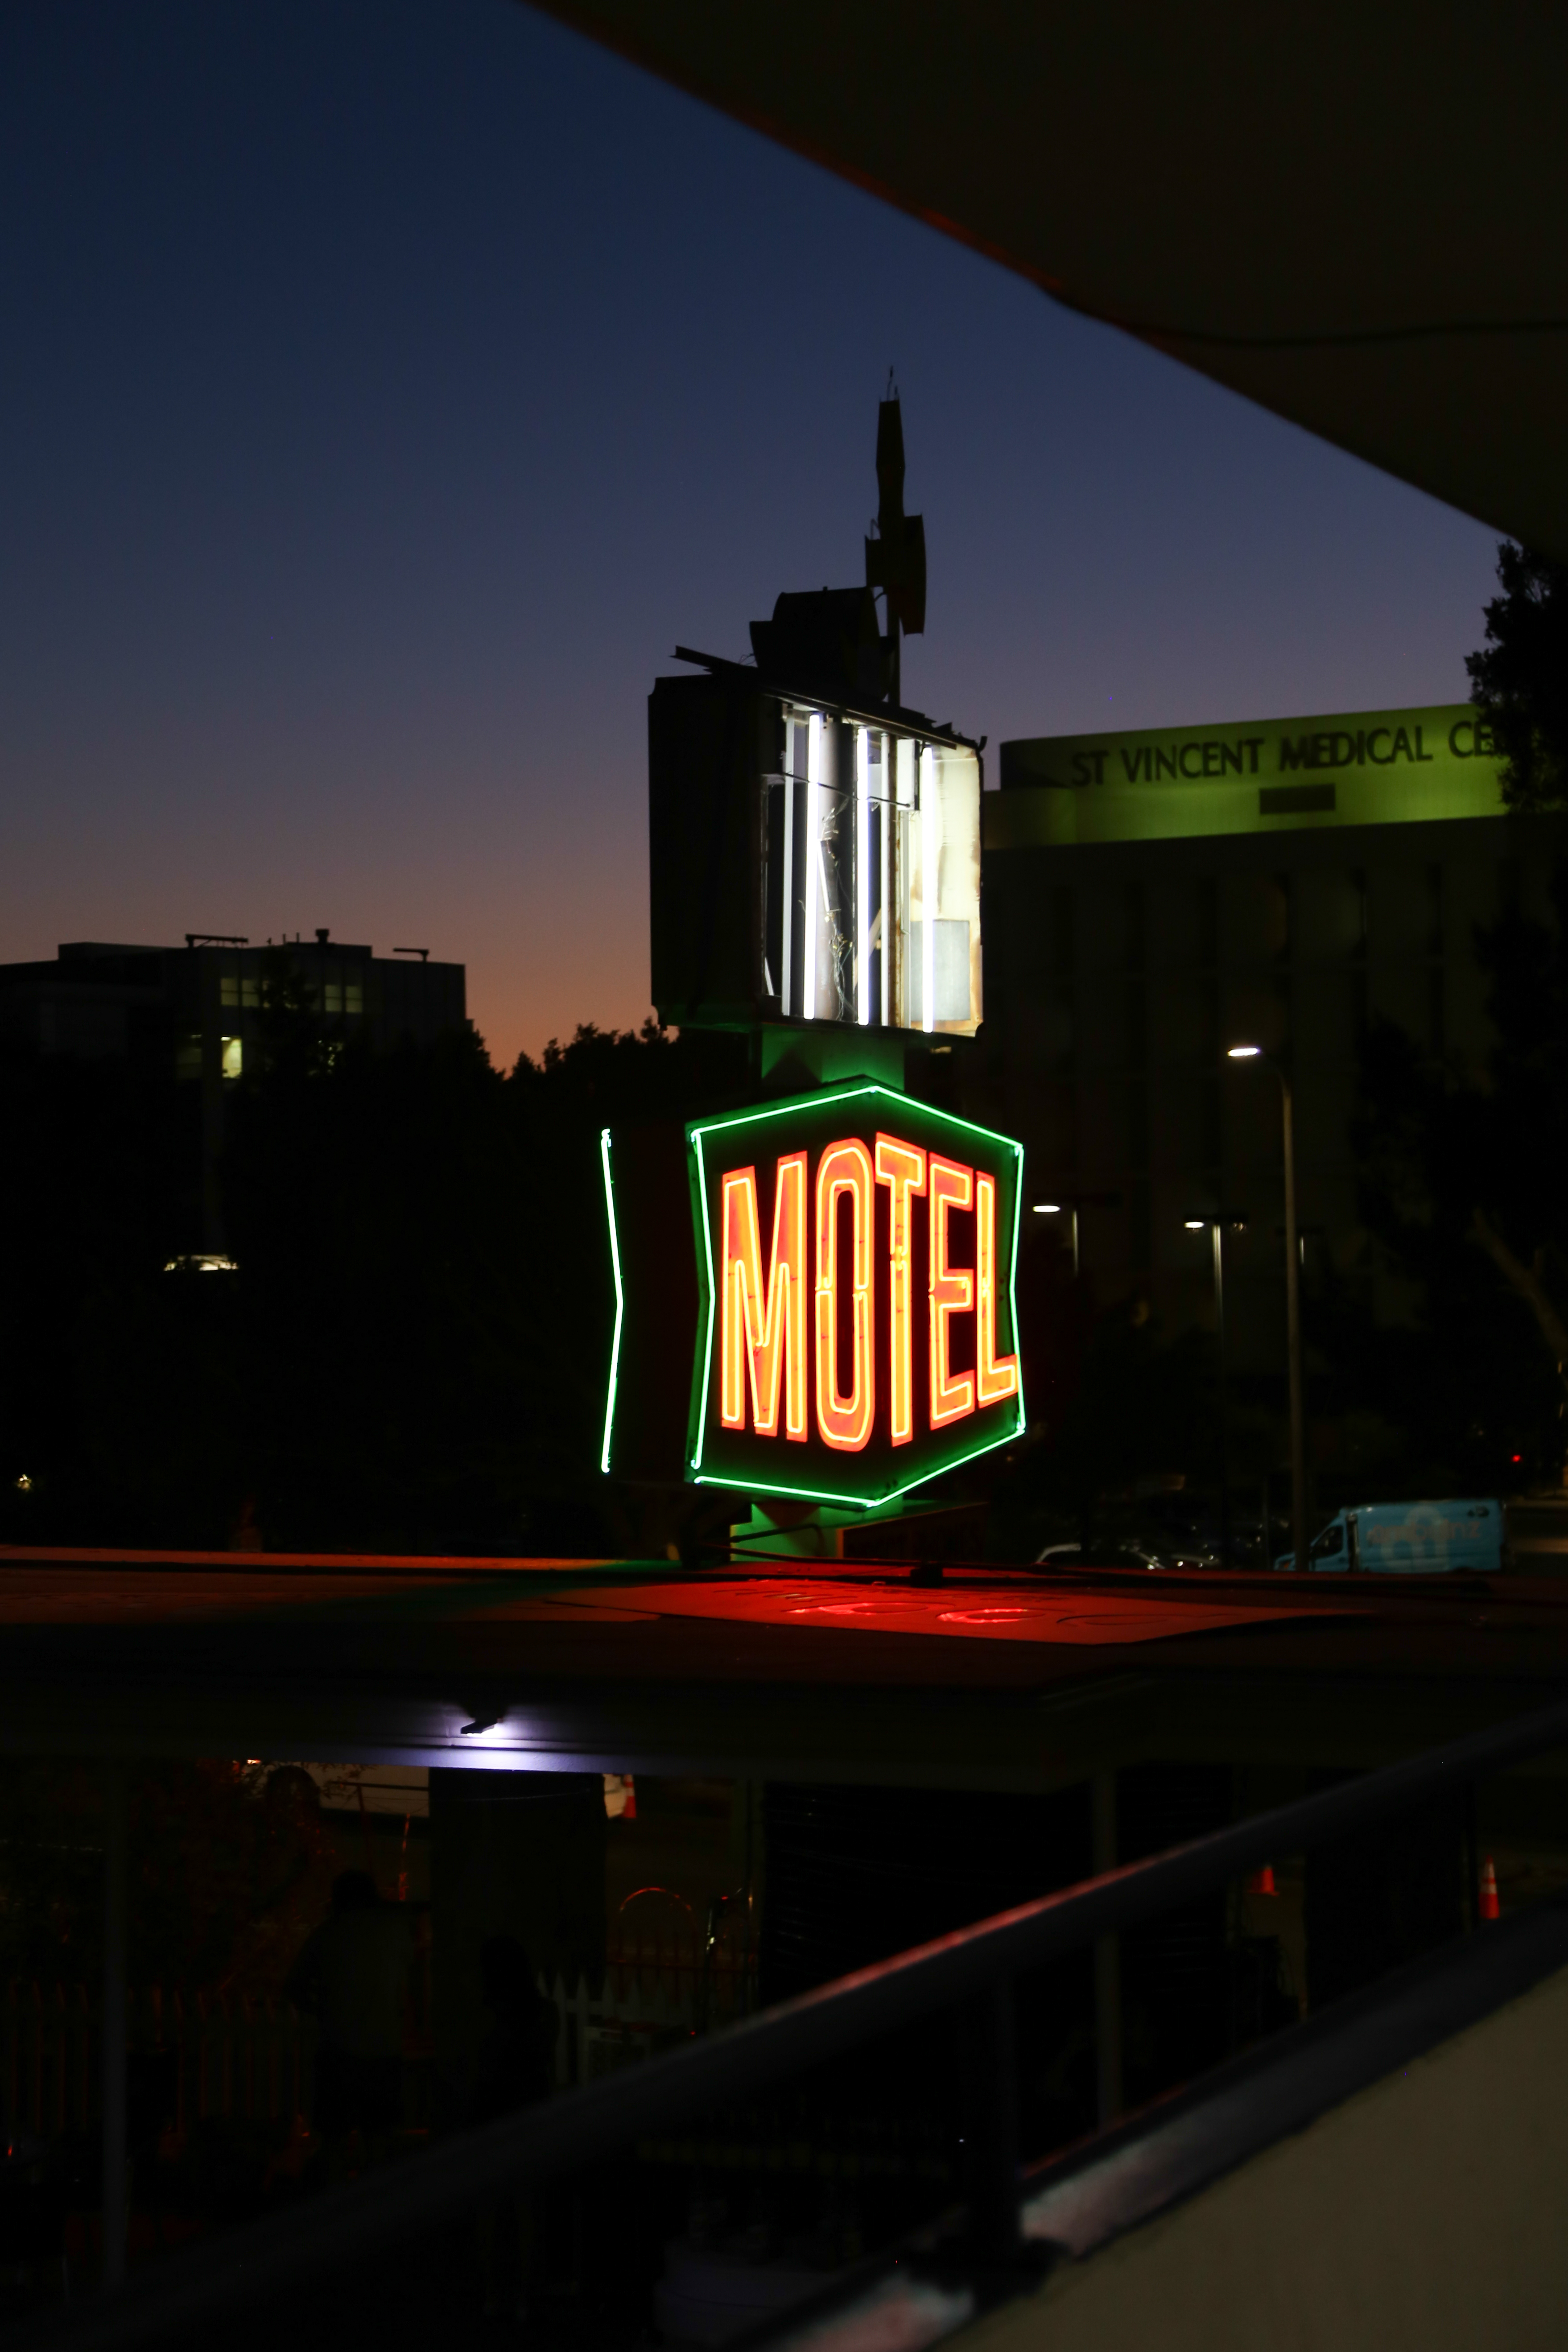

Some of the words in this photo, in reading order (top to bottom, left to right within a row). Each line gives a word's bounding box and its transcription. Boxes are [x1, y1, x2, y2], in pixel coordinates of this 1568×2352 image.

[1070, 749, 1109, 788] ST
[1120, 738, 1265, 784] VINCENT
[1279, 726, 1434, 772] MEDICAL
[721, 1131, 1017, 1452] MOTEL
